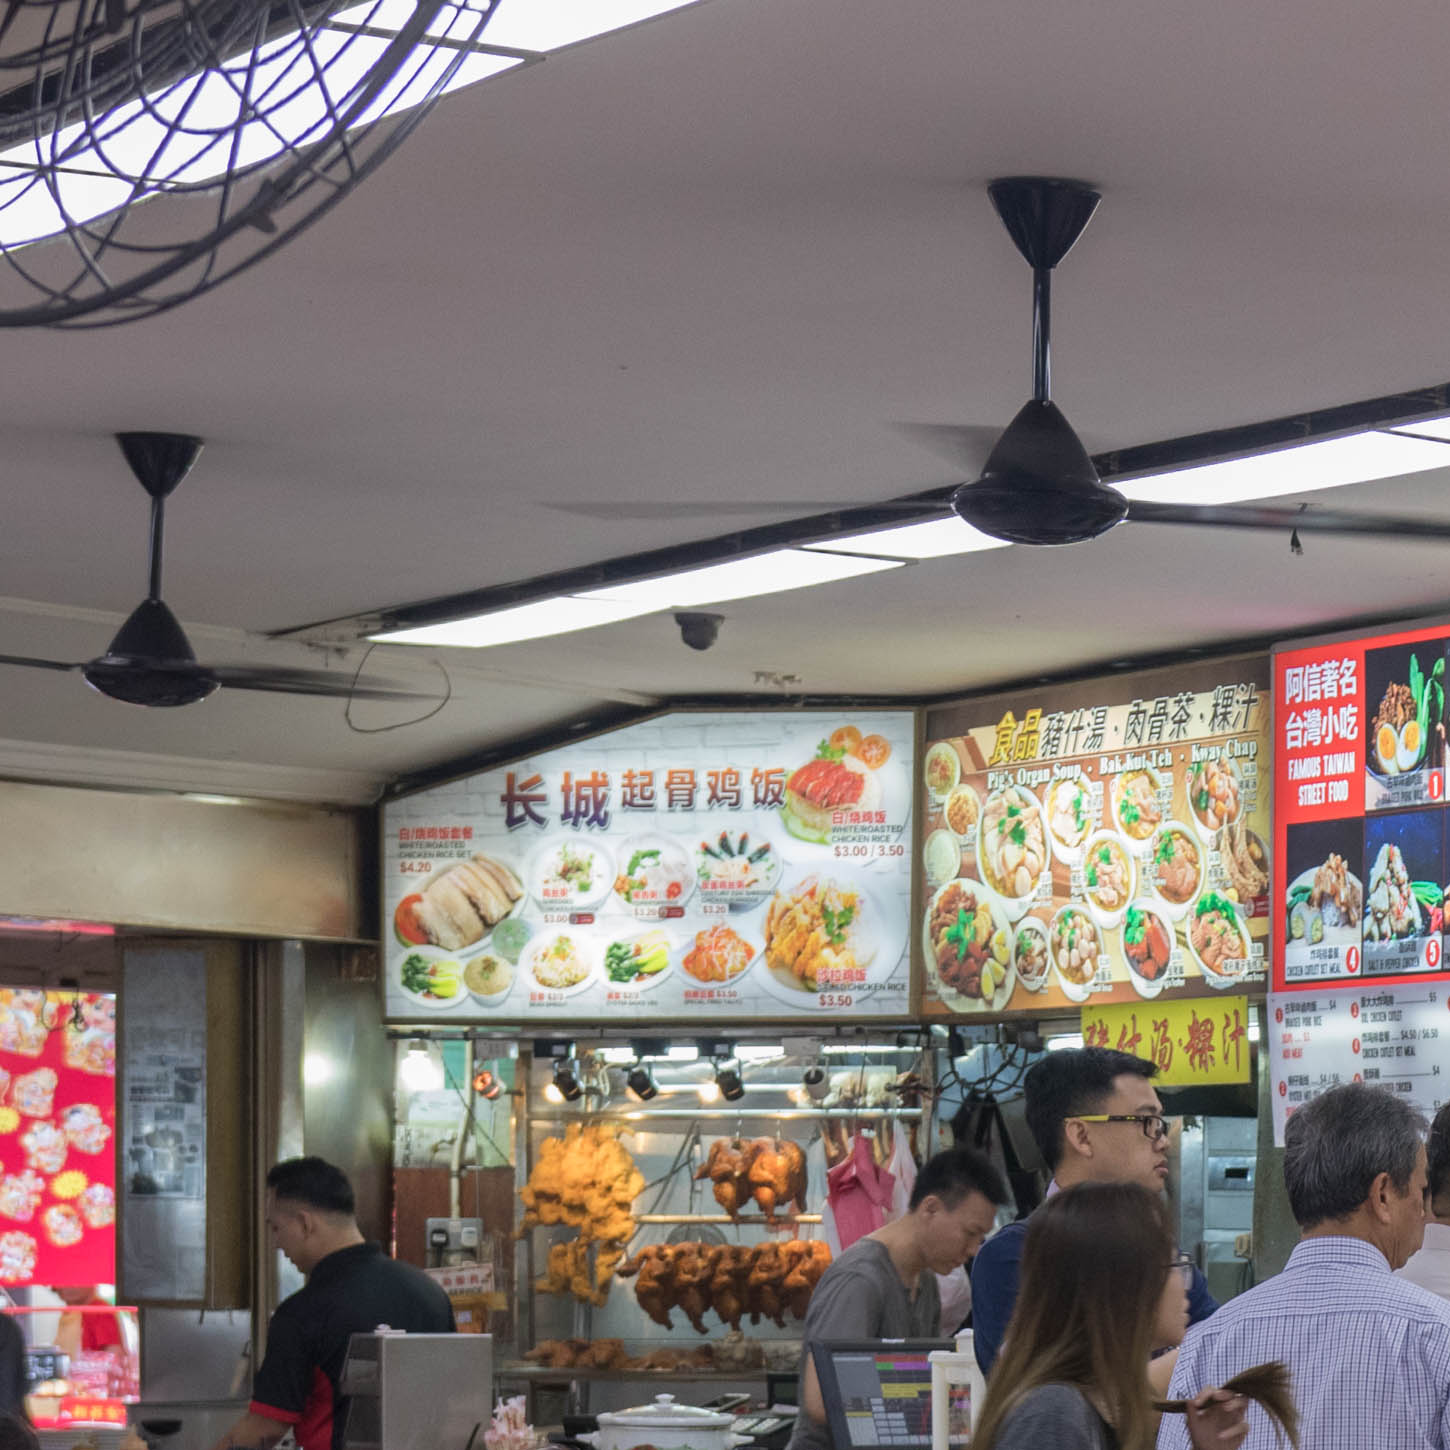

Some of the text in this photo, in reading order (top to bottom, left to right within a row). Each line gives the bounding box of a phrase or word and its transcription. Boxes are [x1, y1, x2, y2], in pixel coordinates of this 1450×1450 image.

[1285, 658, 1357, 704] 阿信著名
[1285, 704, 1359, 749] 台灣小吃
[987, 739, 1257, 789] Pig's Organ Soup Bak Kut Teh Kway Chap
[1288, 752, 1355, 780] FAMOUS TAIWAN
[1298, 780, 1348, 806] STREET FOOD
[1432, 776, 1439, 794] 1
[501, 768, 787, 832] 长城起骨鸡饭
[832, 811, 887, 825] 白/烧鸡饭
[832, 835, 891, 843] CHICKEN RICE
[834, 845, 904, 857] $3.00 3.50
[400, 861, 431, 872] $4.20
[1349, 952, 1357, 968] 4
[1428, 944, 1437, 962] 5
[819, 995, 852, 1007] $3.50
